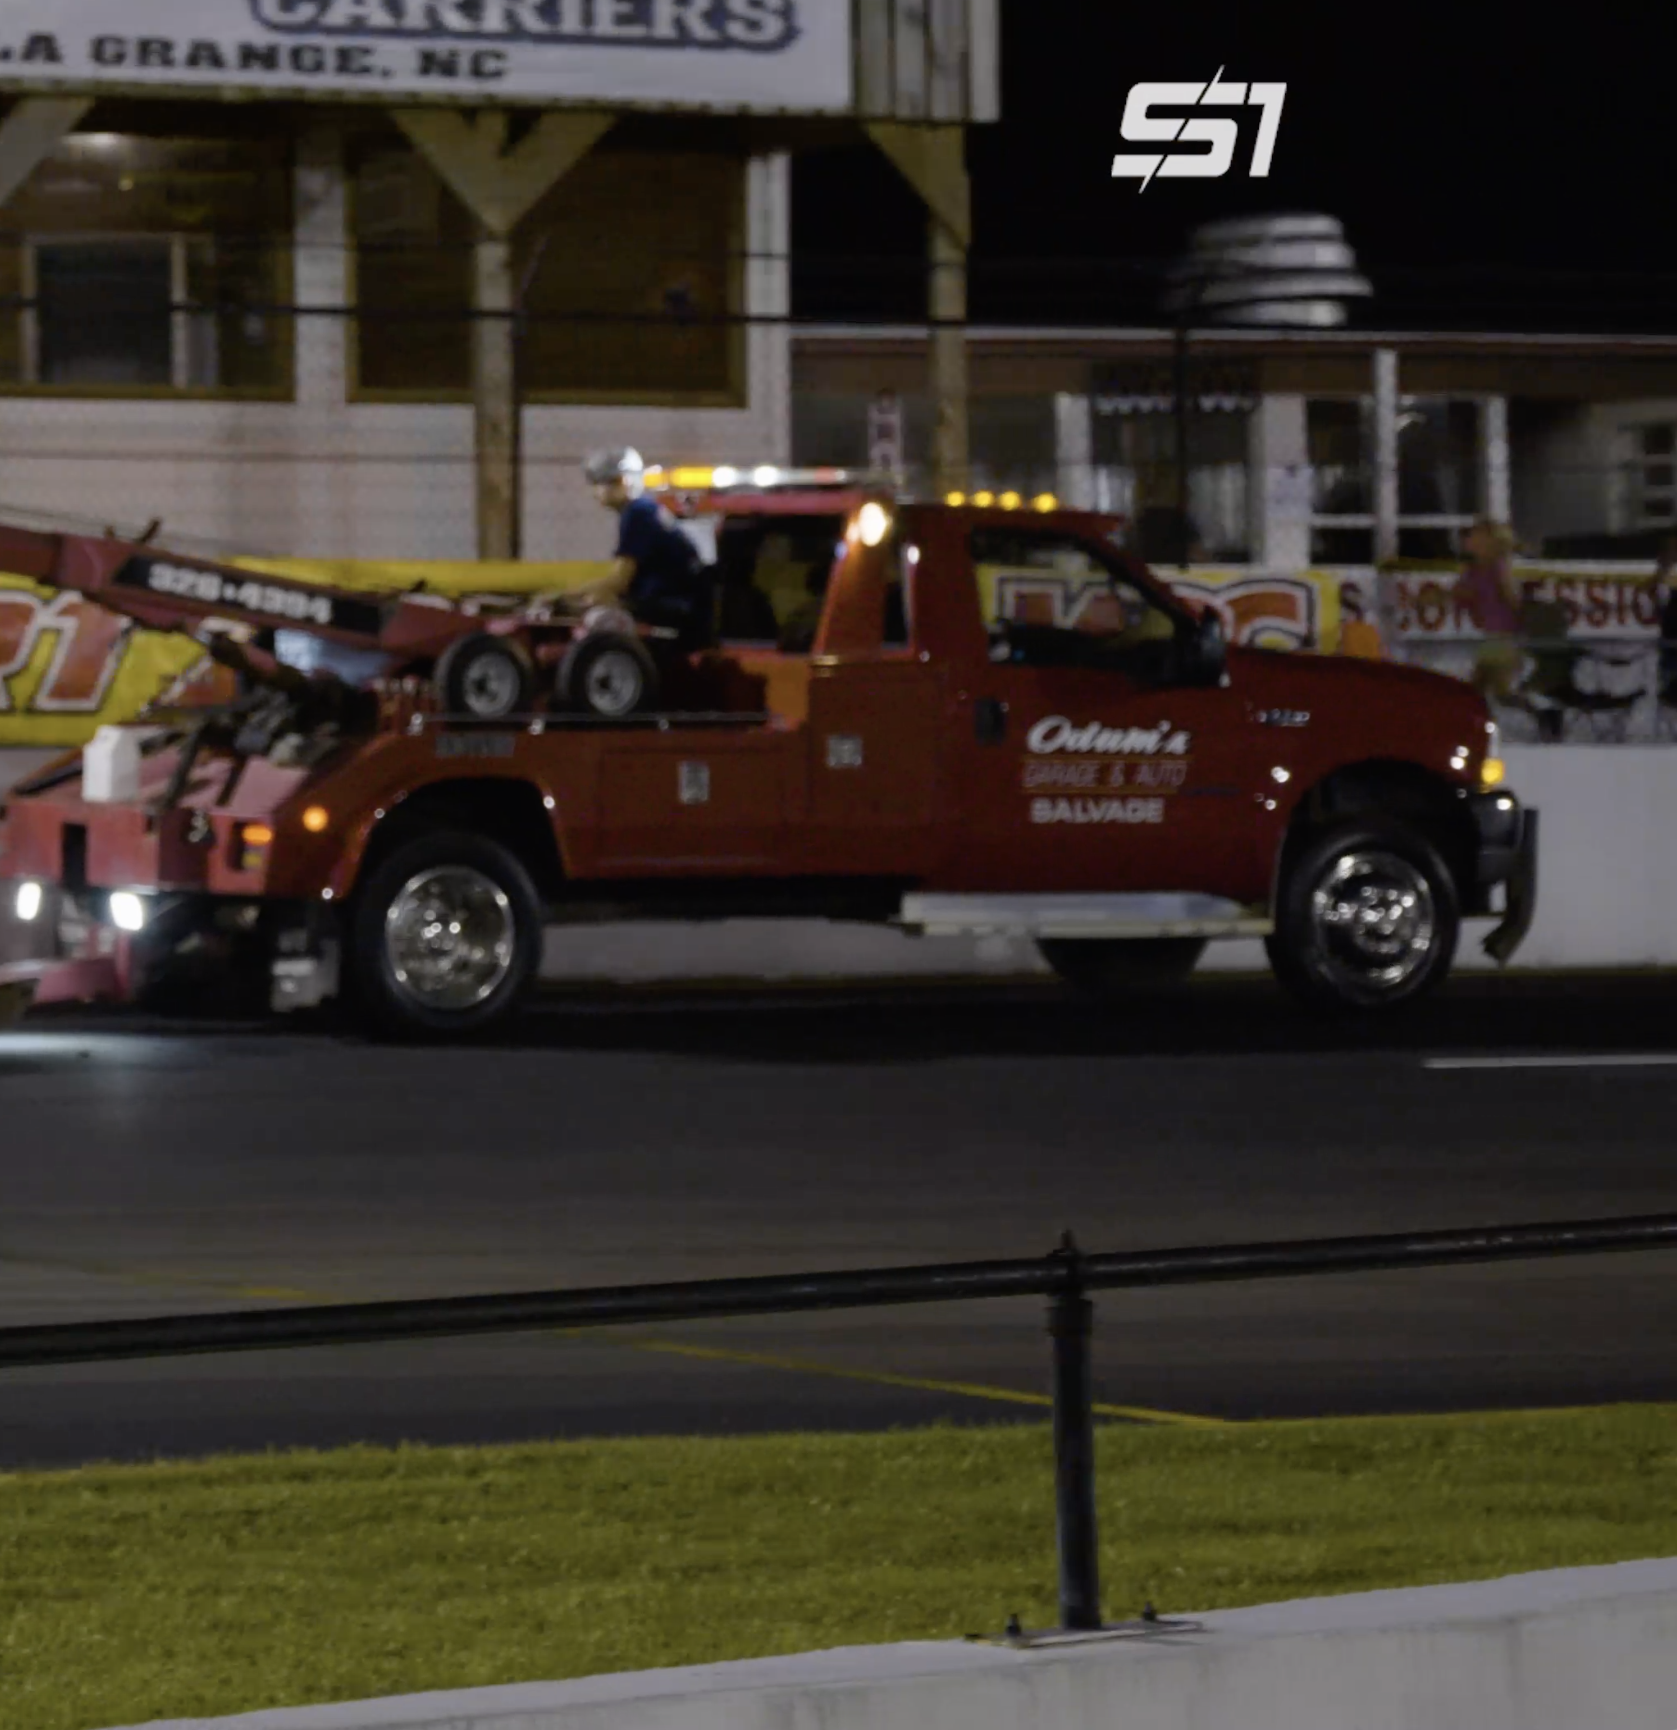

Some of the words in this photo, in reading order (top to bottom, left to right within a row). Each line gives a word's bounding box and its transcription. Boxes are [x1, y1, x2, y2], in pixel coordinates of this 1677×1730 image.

[89, 33, 394, 79] GRANGE,
[418, 48, 509, 80] NC
[1026, 713, 1192, 755] Odum's
[1030, 798, 1166, 824] SALVAGE
